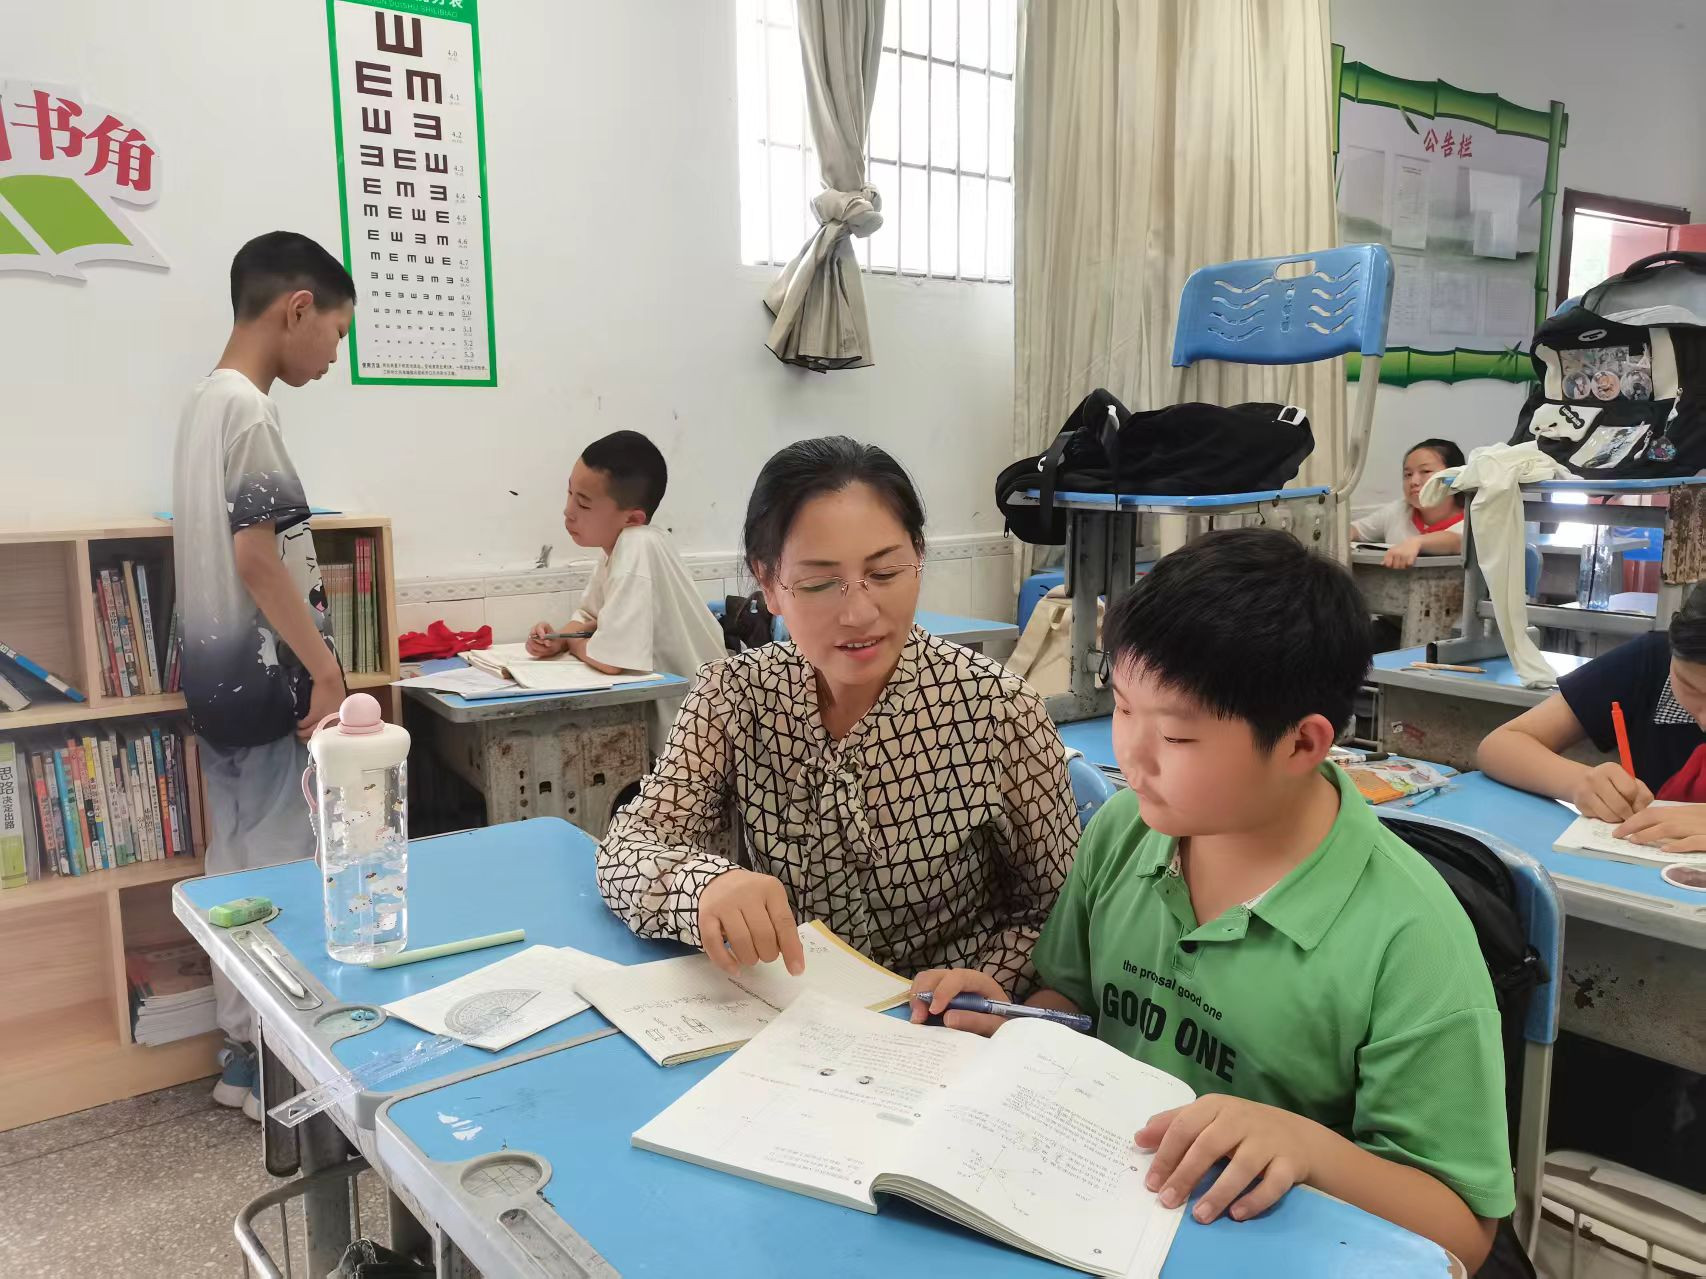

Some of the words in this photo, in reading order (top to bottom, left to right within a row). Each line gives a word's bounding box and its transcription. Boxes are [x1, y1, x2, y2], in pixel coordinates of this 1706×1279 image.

[449, 93, 460, 101] 4.1
[0, 90, 155, 191] 书角
[451, 131, 462, 139] 4.2
[1423, 128, 1473, 159] 公告栏
[453, 165, 464, 173] 4.3
[459, 259, 469, 267] 4.7
[1122, 959, 1138, 974] the
[1177, 986, 1202, 1007] good
[1203, 1004, 1223, 1021] one
[1102, 982, 1167, 1042] GOOD
[1174, 1017, 1237, 1084] ONE
